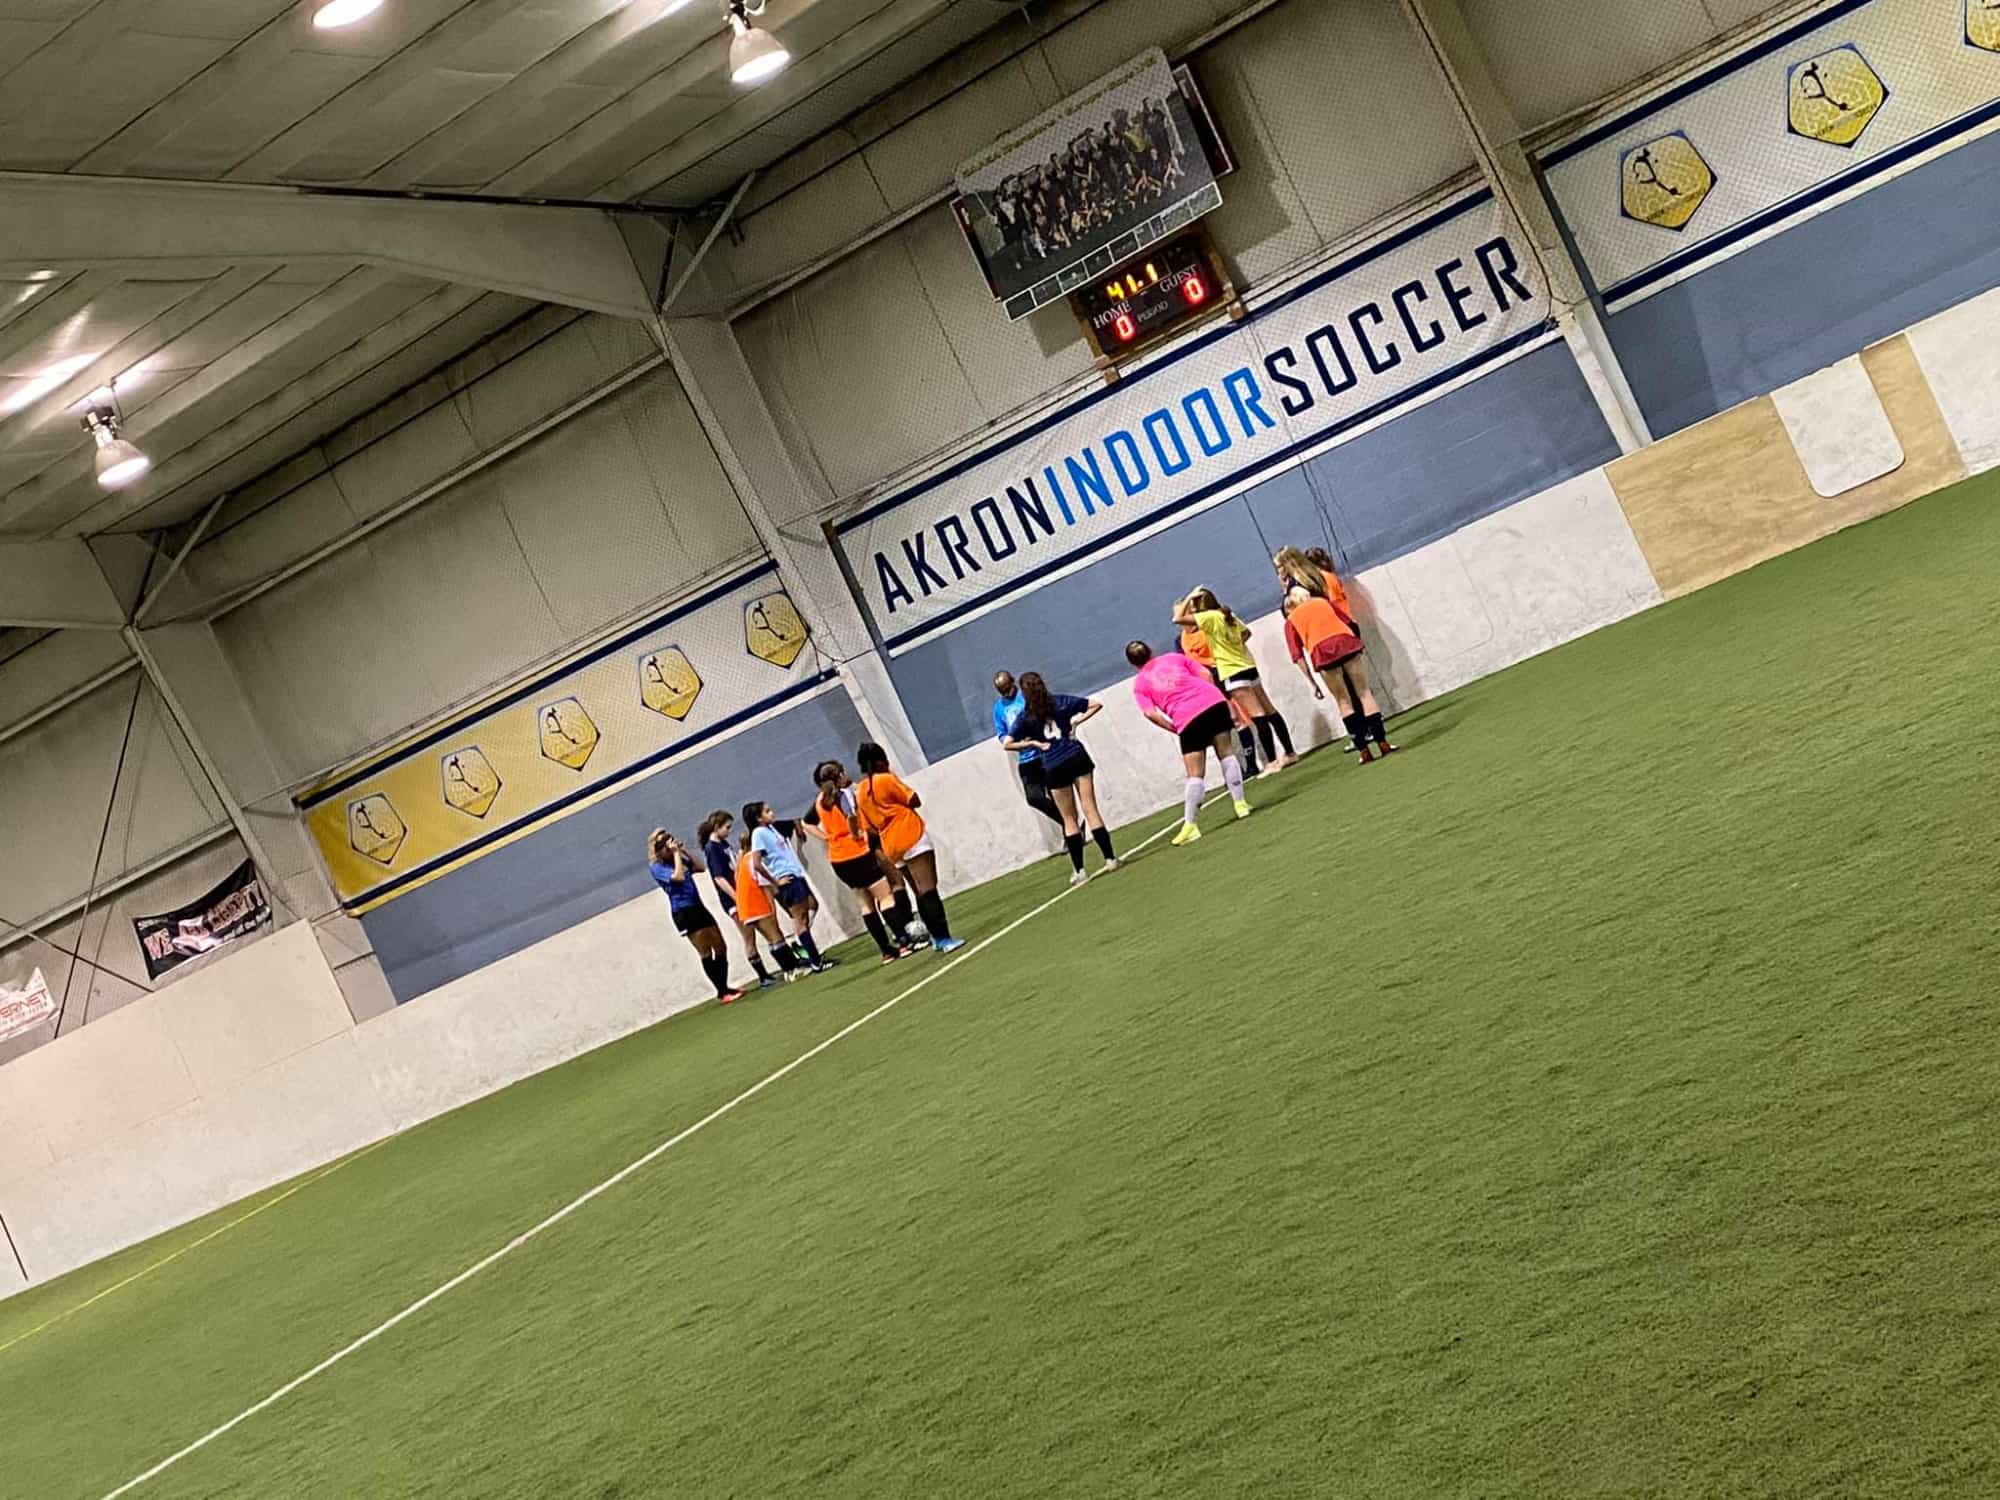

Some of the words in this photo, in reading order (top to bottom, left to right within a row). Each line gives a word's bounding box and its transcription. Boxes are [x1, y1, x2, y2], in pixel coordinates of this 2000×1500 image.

[1159, 264, 1198, 294] GUEST
[1184, 277, 1205, 303] 0
[1092, 300, 1133, 329] HOME
[1115, 314, 1136, 339] 0
[1043, 719, 1063, 740] 4
